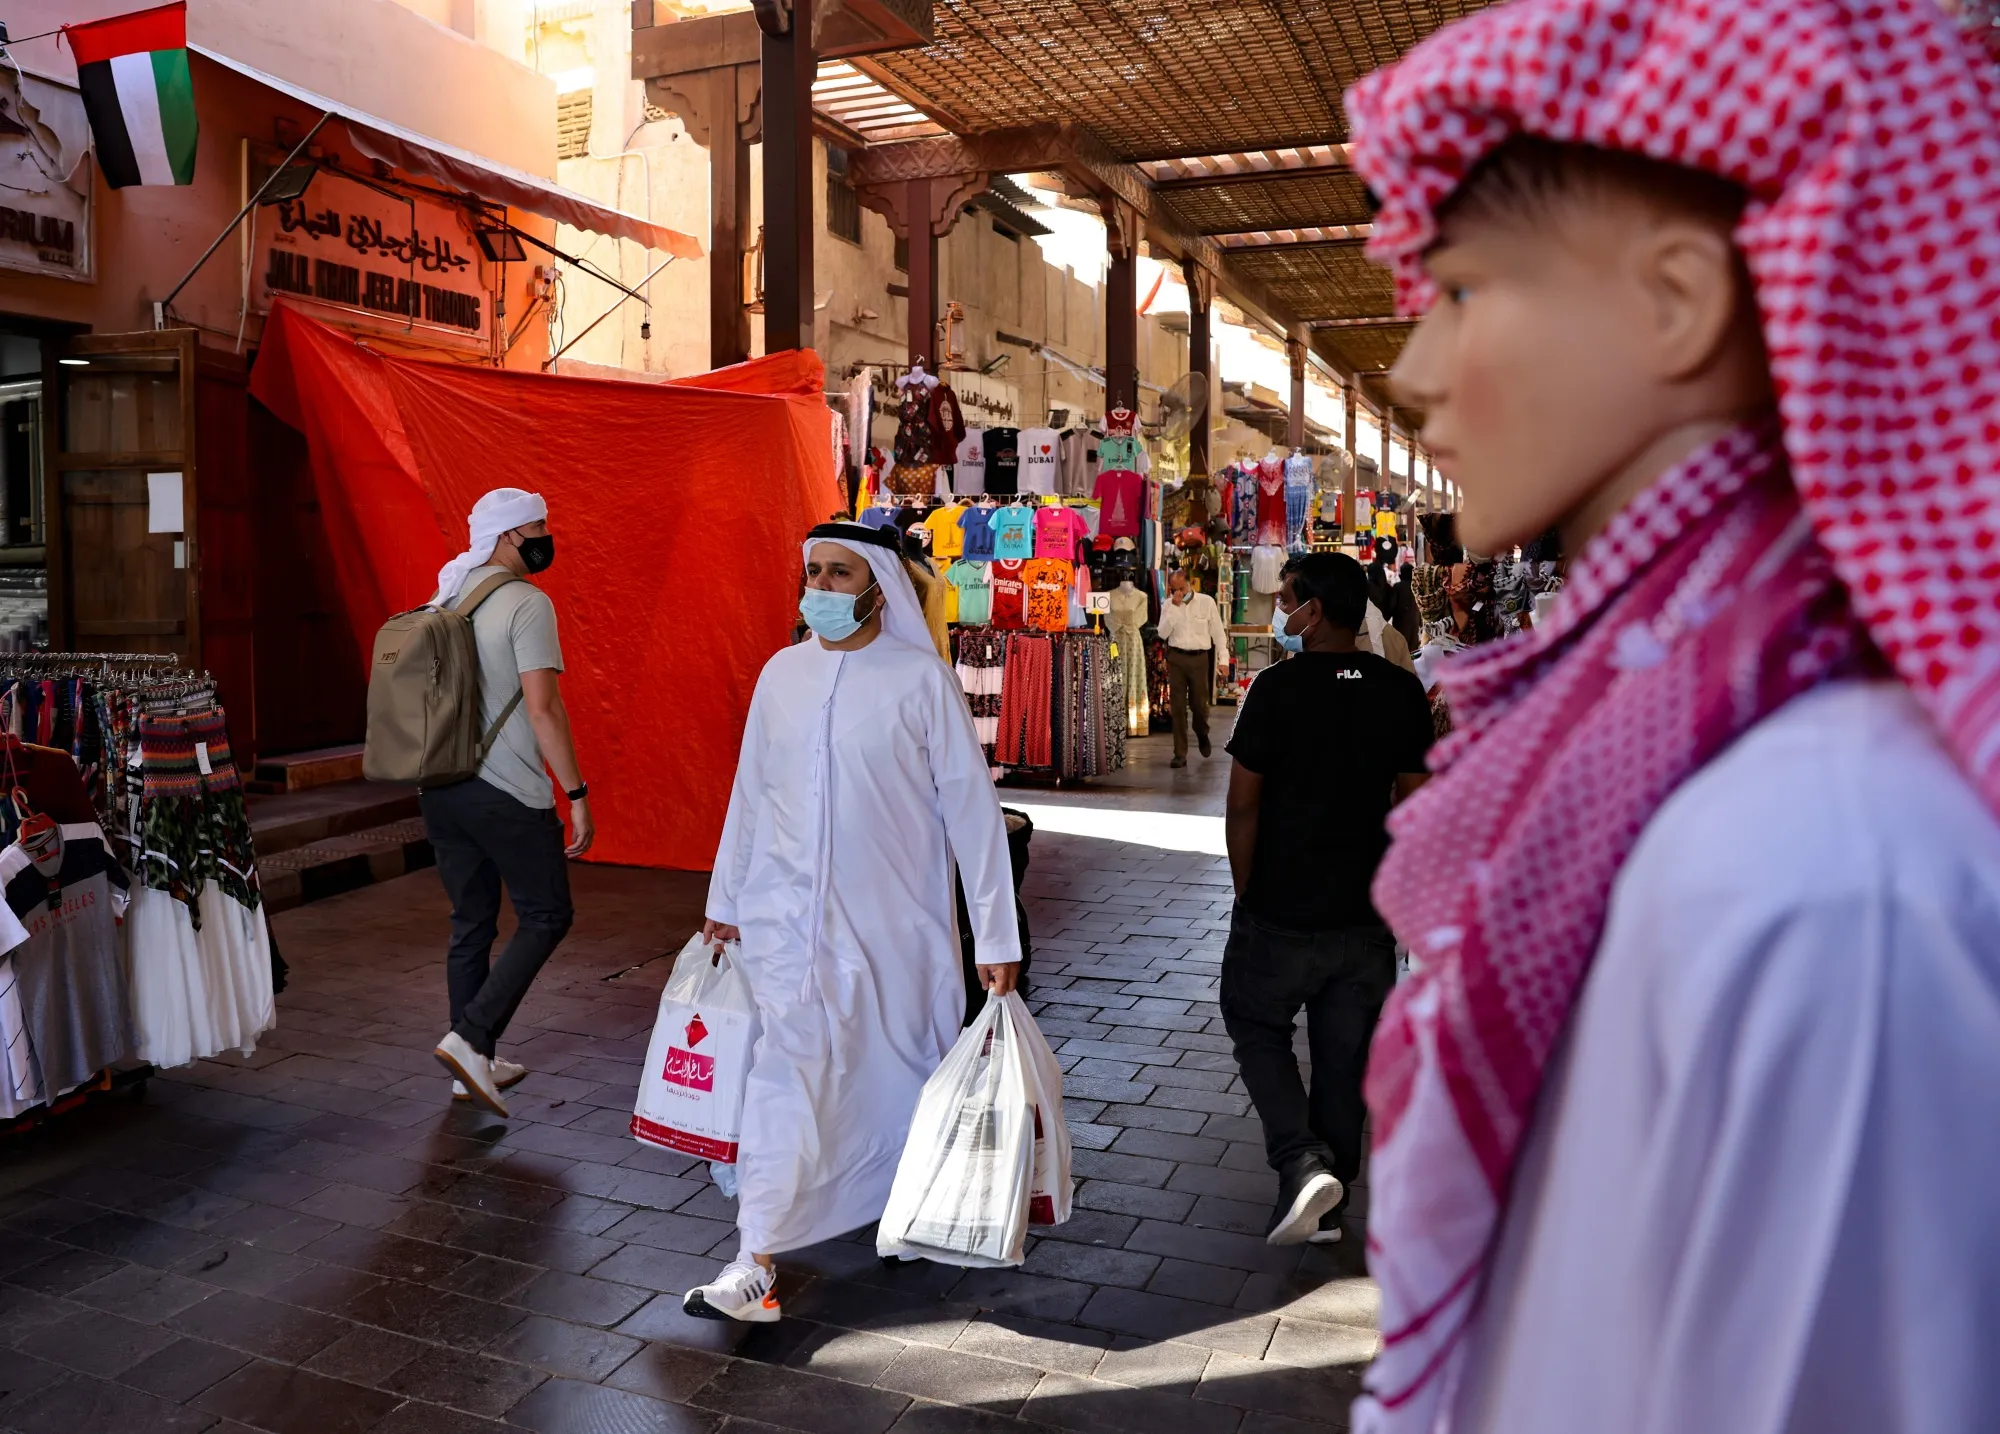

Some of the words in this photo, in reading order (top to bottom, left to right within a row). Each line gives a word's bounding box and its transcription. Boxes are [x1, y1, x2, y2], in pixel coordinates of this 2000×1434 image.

[266, 247, 314, 296] JALIL
[315, 258, 360, 305] KHAN
[422, 284, 481, 331] TRADING
[962, 460, 985, 468] Emirates
[1028, 456, 1054, 464] DUBAI
[964, 581, 990, 591] Emirate
[994, 578, 1022, 589] Emirates
[1034, 580, 1060, 591] Jeep
[1093, 596, 1109, 609] 10
[381, 652, 396, 661] YETI
[1336, 669, 1362, 679] FILA
[28, 916, 47, 937] LOS
